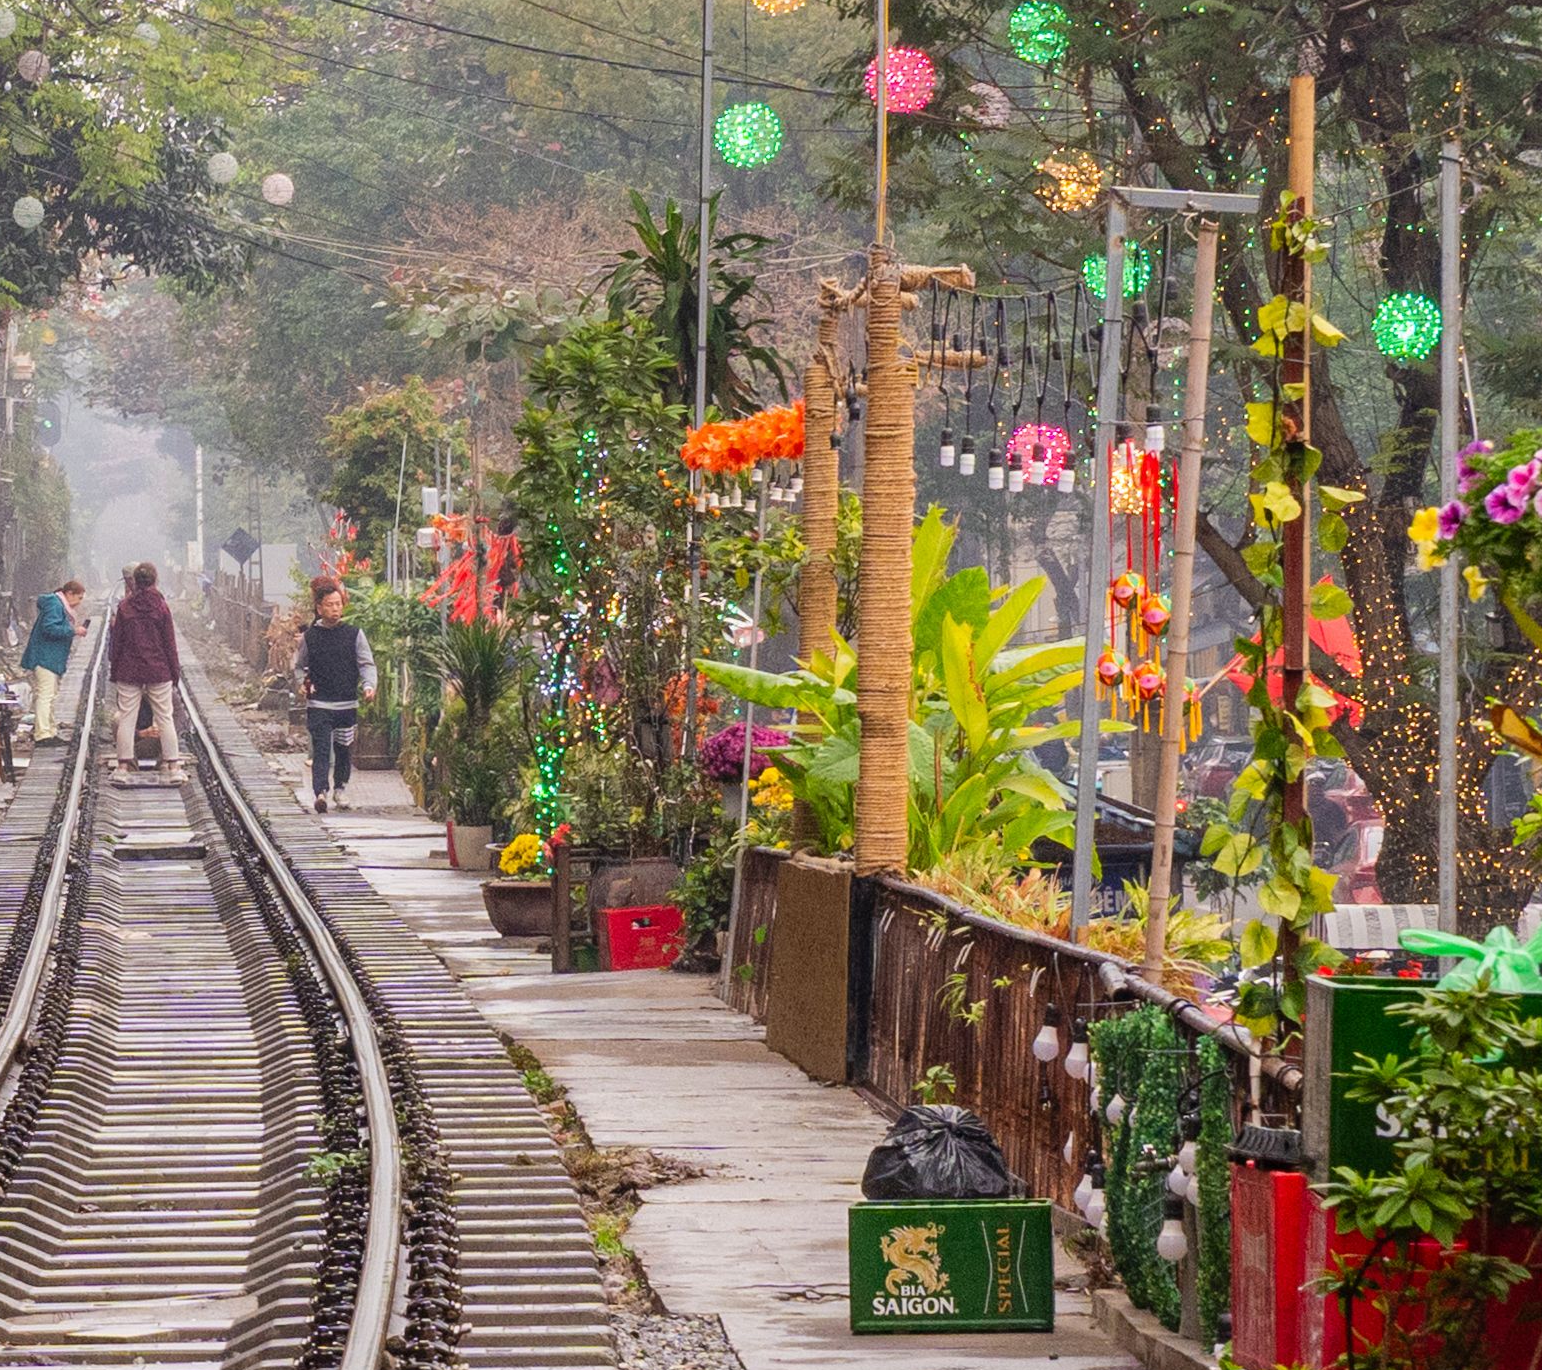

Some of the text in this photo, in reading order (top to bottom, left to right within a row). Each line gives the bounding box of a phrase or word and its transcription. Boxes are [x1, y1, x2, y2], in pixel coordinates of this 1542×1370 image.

[996, 1222, 1013, 1314] SPECIAL
[900, 1286, 927, 1297] BIA
[872, 1296, 955, 1316] SAIGON
